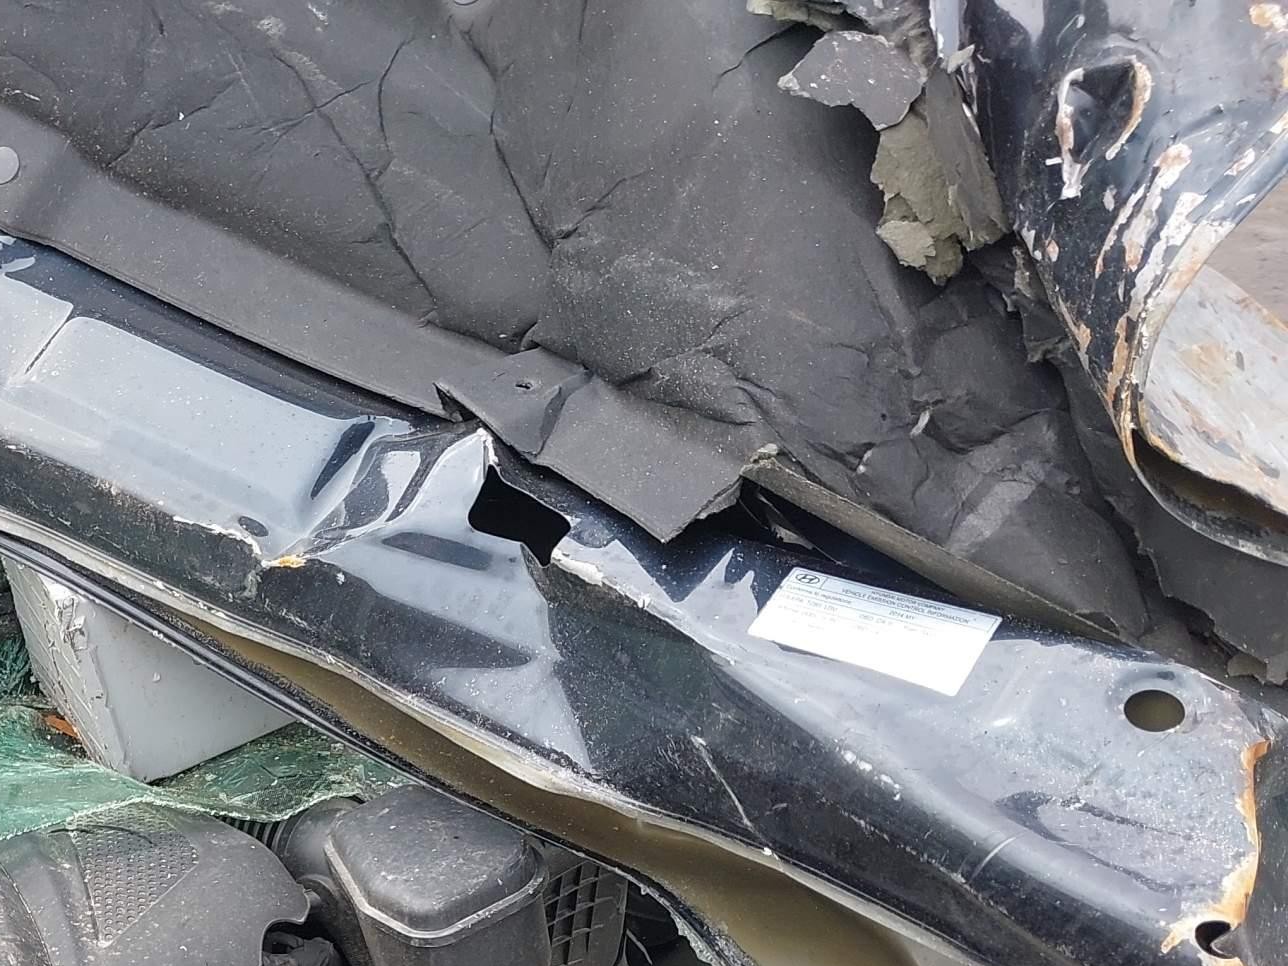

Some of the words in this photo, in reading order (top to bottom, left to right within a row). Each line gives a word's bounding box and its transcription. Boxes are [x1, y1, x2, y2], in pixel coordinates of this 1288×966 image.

[840, 588, 866, 597] VEHICLE
[865, 594, 897, 605] EMISSION
[895, 602, 926, 613] CONTROL
[925, 609, 970, 624] INFORMATION
